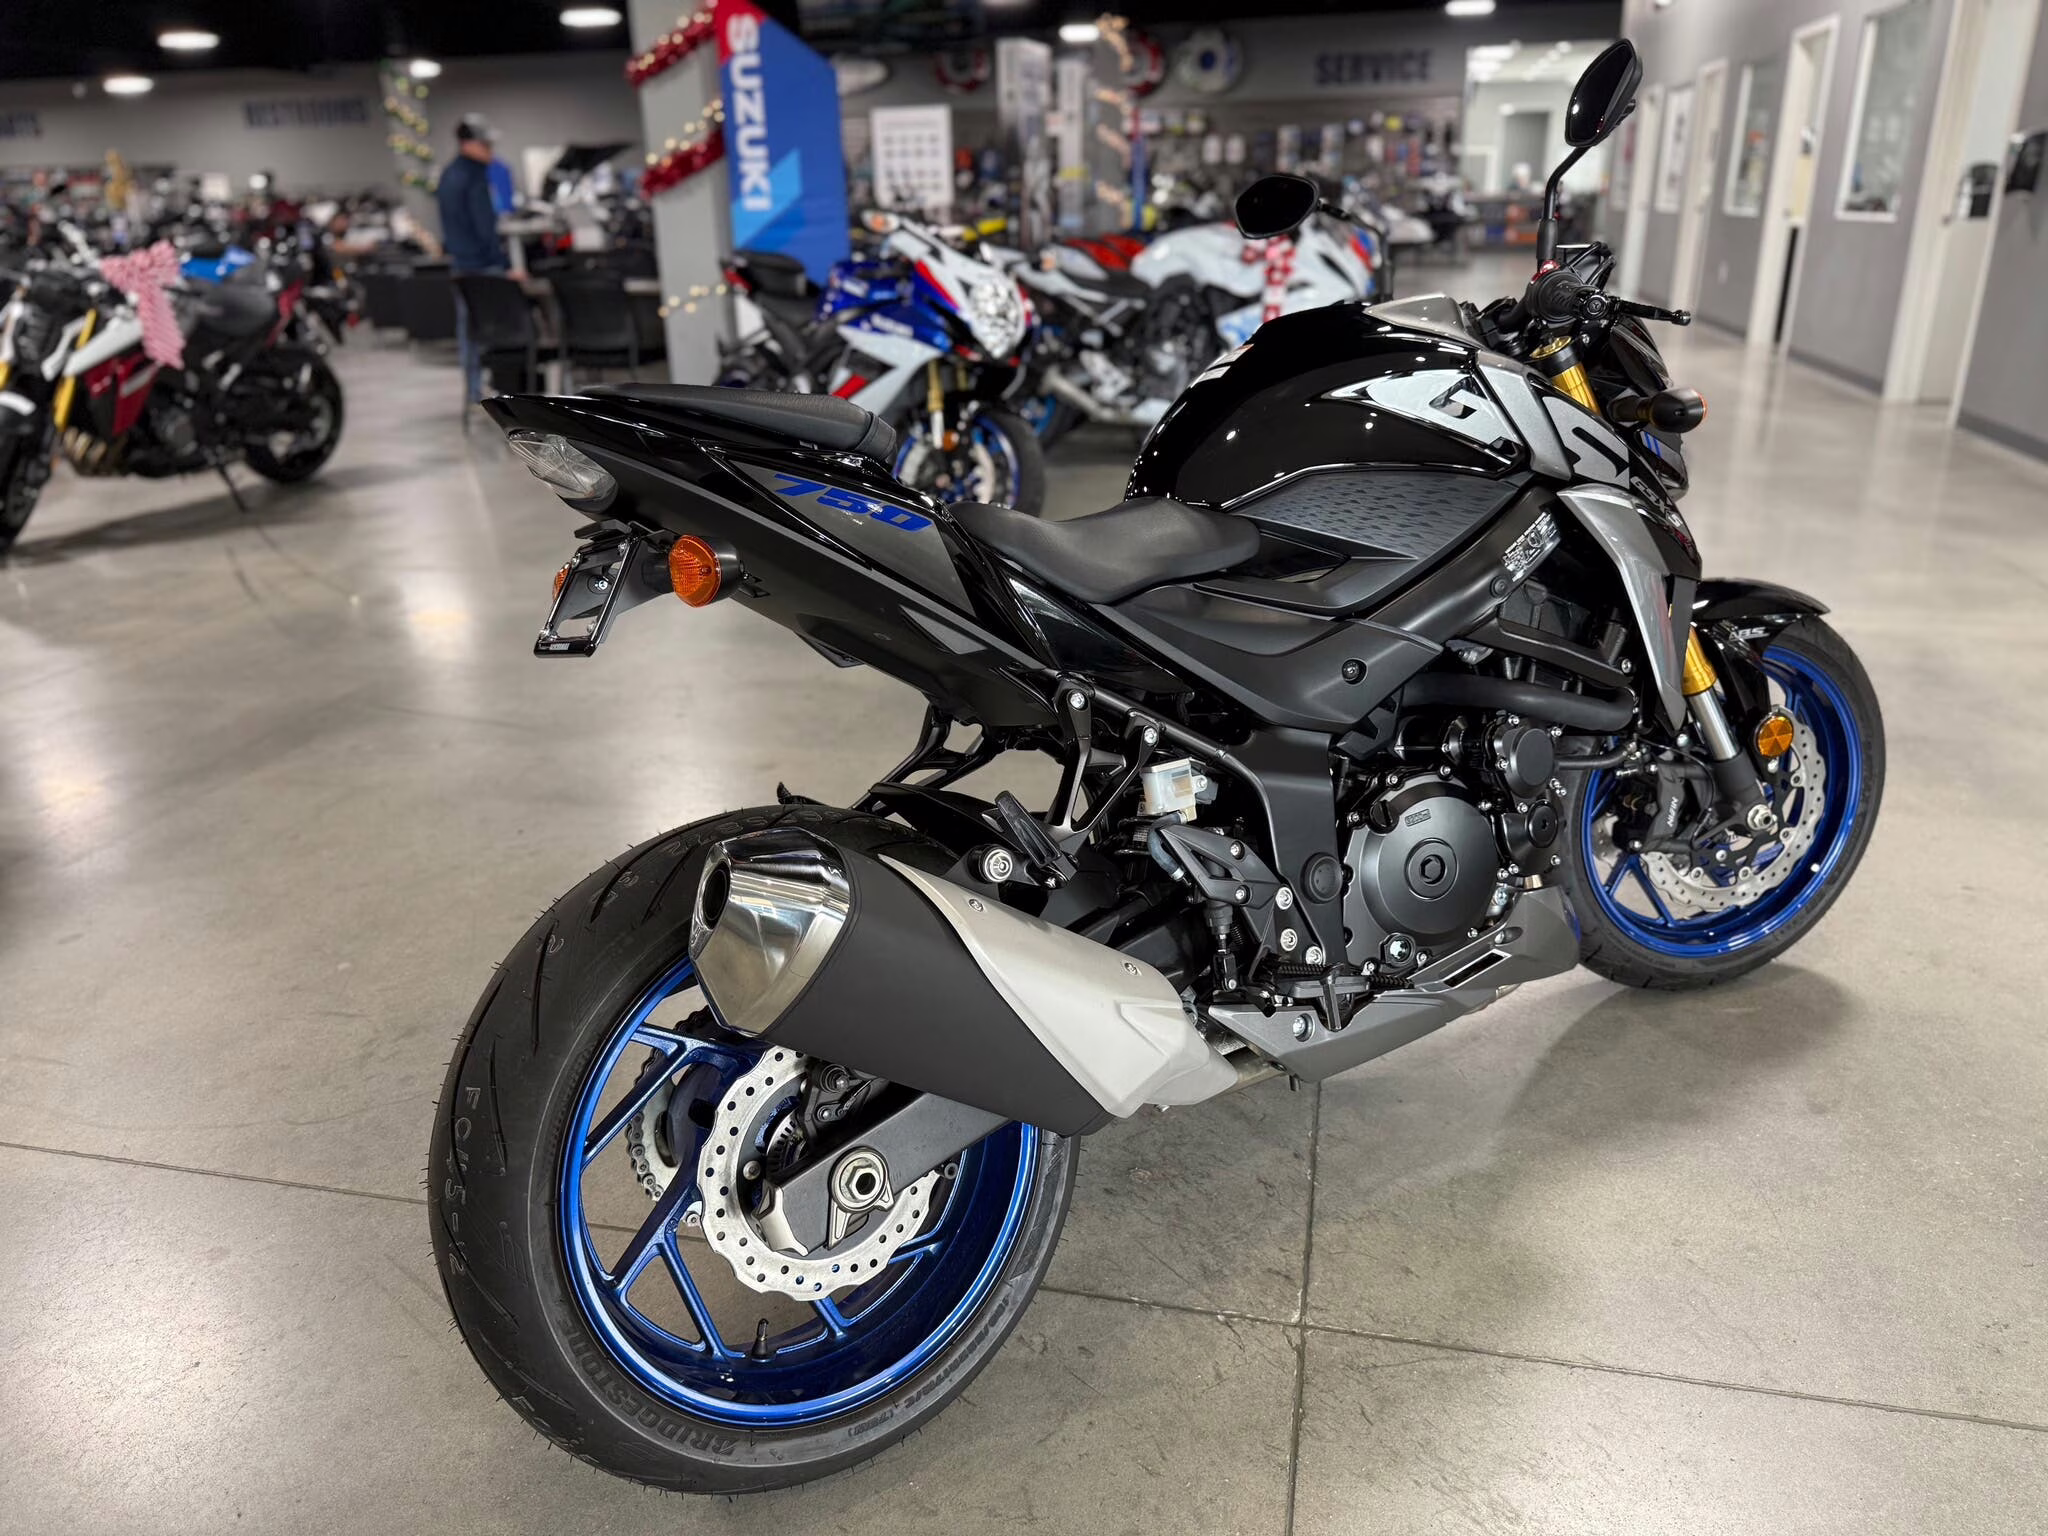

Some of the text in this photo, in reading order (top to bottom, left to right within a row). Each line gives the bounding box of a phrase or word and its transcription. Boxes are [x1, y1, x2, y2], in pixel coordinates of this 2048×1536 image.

[1315, 49, 1432, 85] SERVICE
[725, 12, 773, 211] SUZUKI
[774, 473, 933, 533] 750
[1728, 626, 1771, 641] ABS
[556, 1313, 736, 1457] BRIDGESTONE
